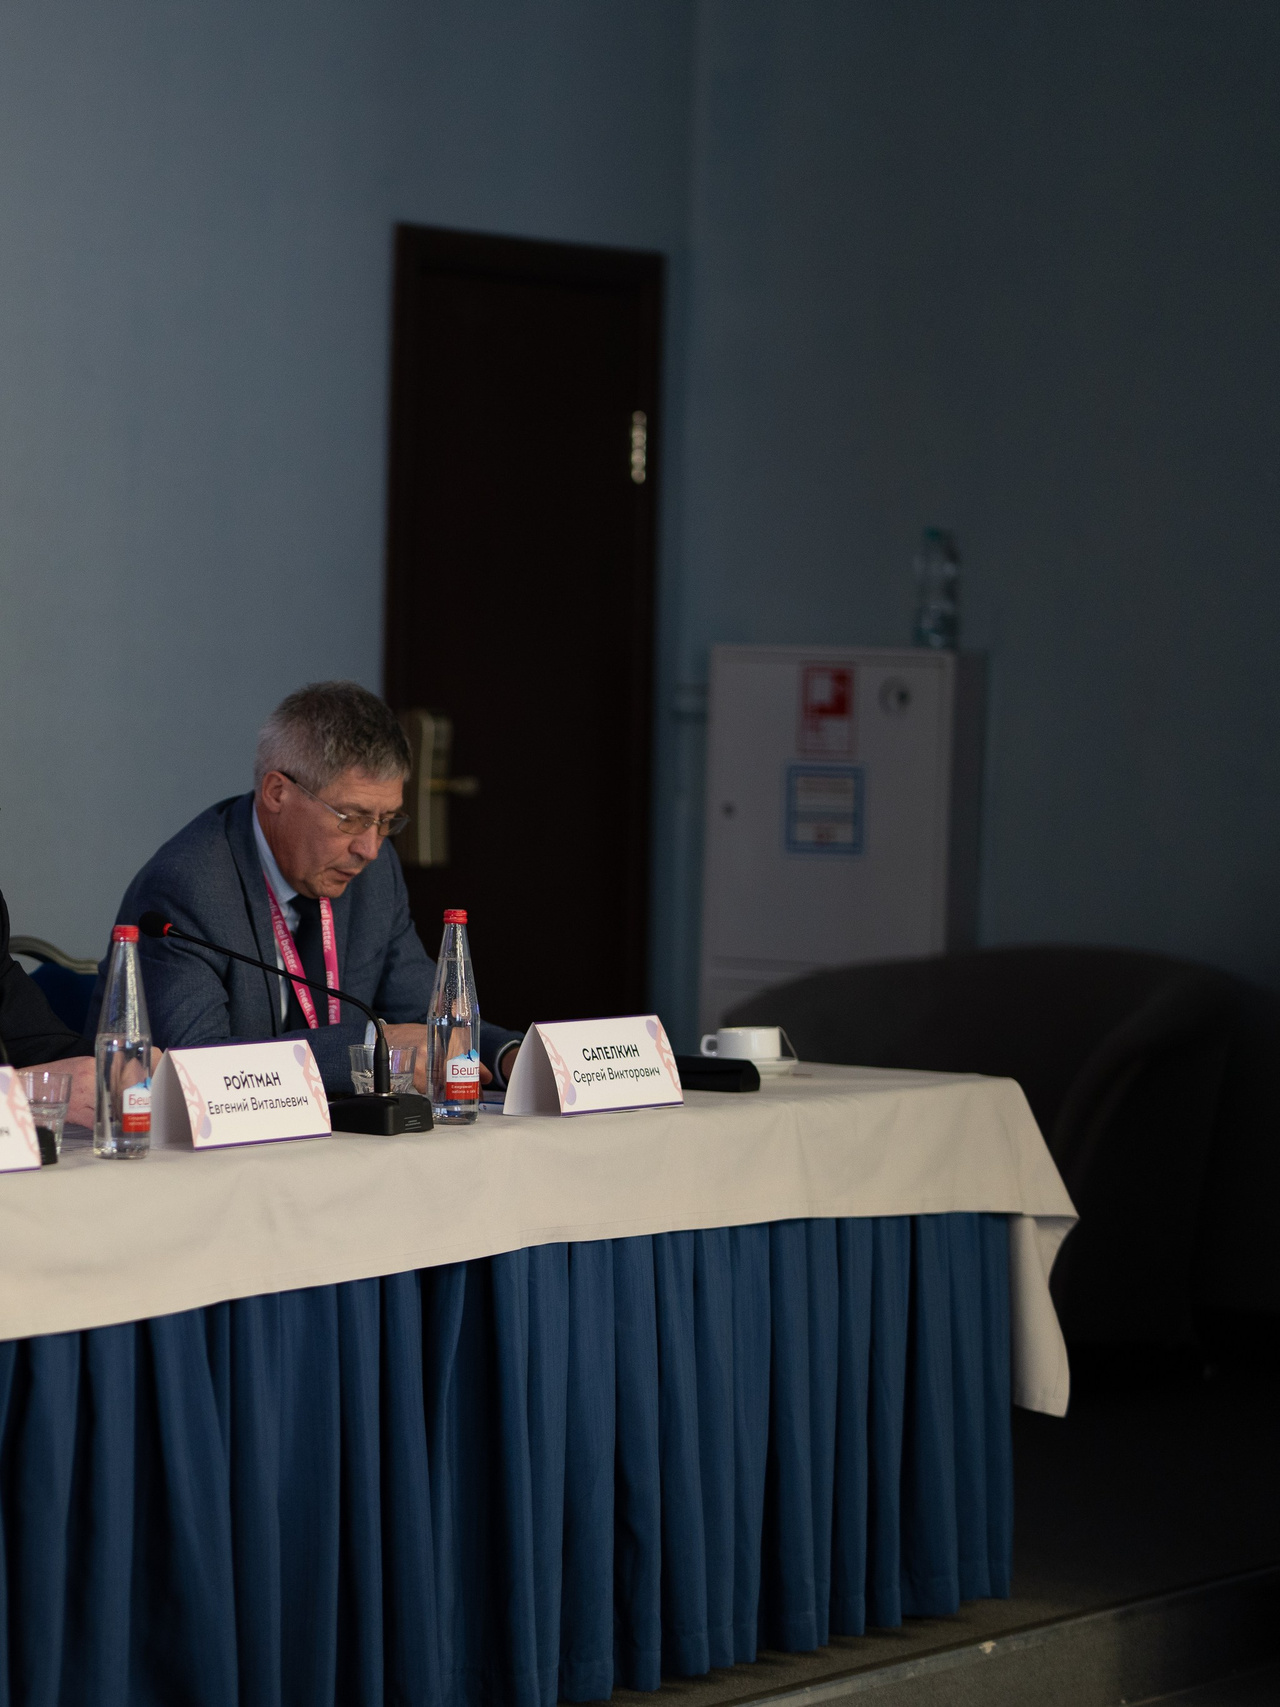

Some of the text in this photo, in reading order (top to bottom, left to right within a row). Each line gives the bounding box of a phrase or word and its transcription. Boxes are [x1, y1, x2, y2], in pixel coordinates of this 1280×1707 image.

[582, 1044, 640, 1061] САПЕЛКИН
[223, 1070, 281, 1090] РОЙТМАН
[573, 1066, 660, 1086] Сергей Викторович
[207, 1096, 309, 1115] Евгений Витальевич
